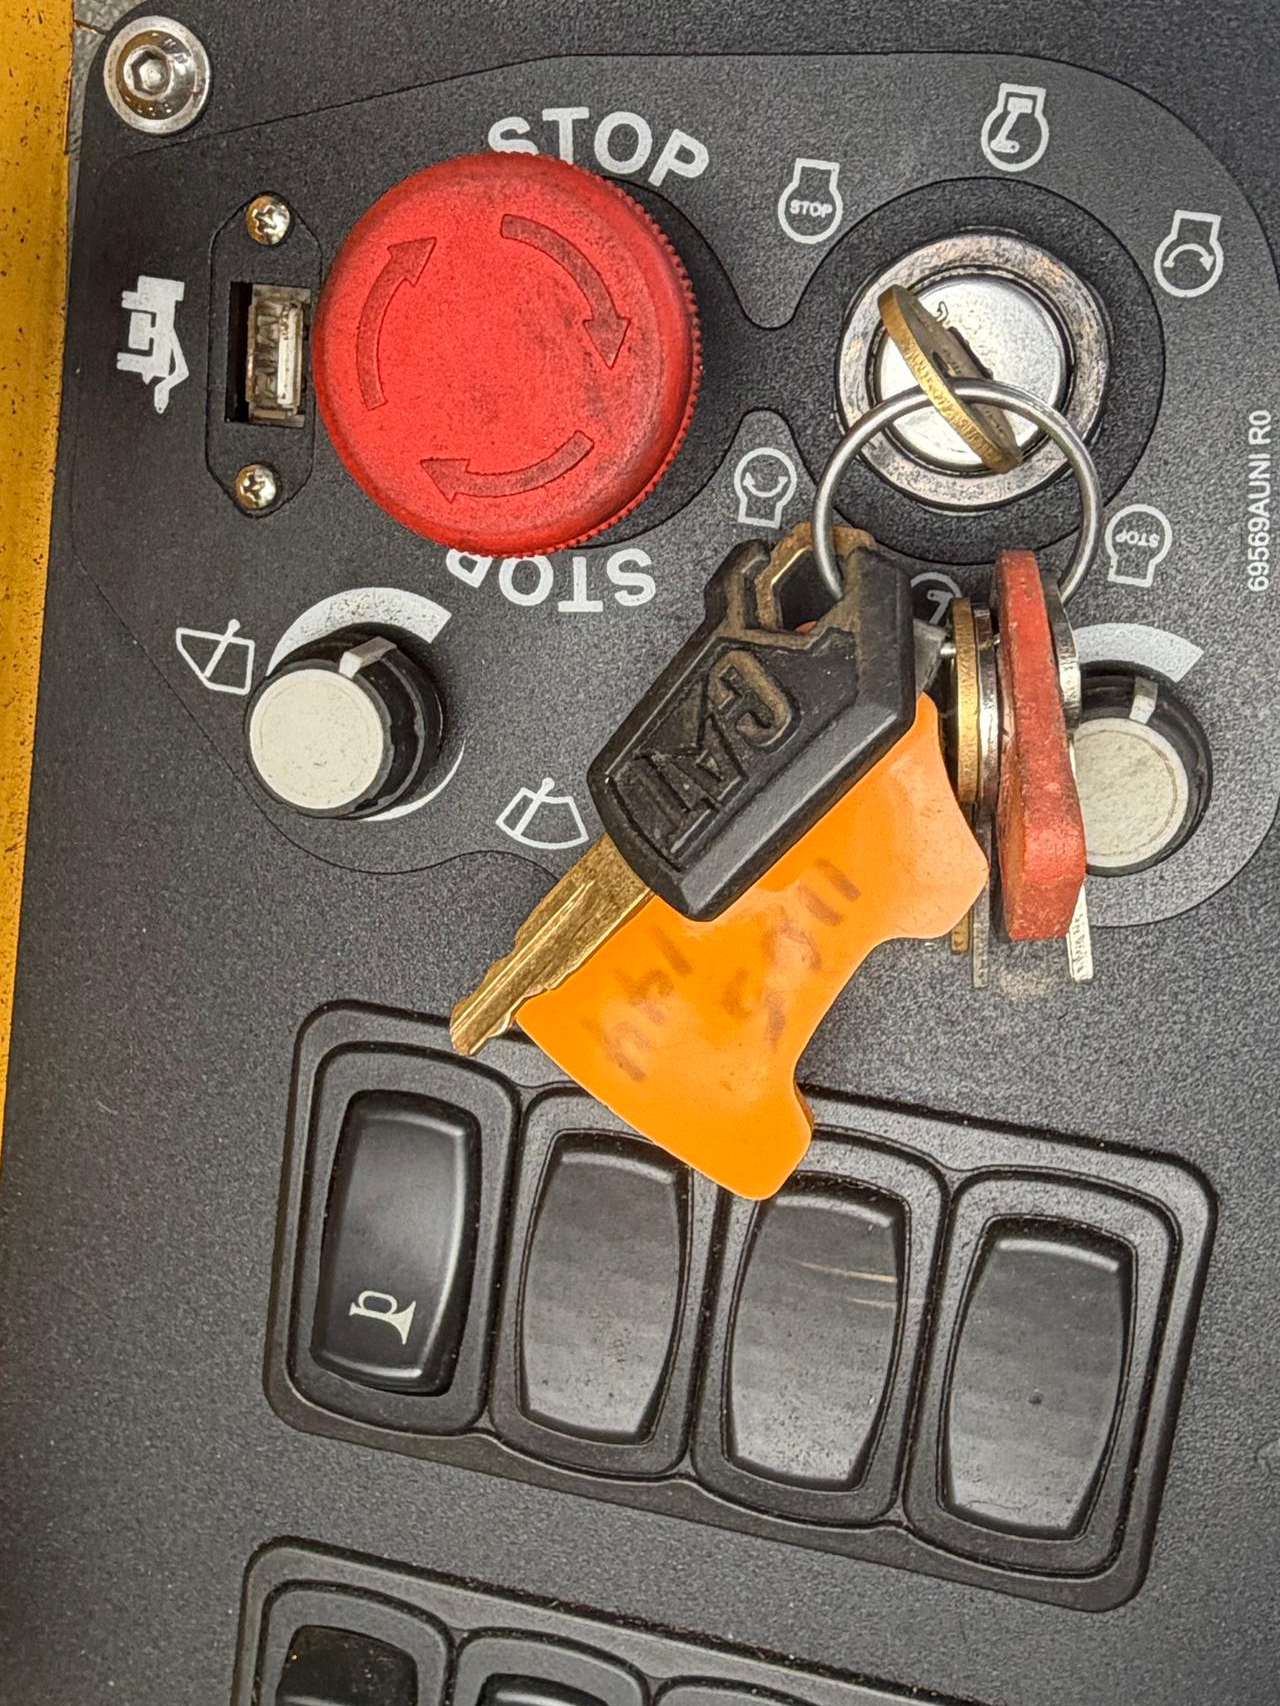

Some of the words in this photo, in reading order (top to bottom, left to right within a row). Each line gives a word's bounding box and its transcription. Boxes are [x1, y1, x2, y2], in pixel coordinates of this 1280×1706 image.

[487, 106, 710, 187] STOP
[789, 199, 834, 219] STOP
[1249, 409, 1272, 451] R0
[1115, 527, 1160, 546] STOP
[1246, 456, 1272, 593] 69569AUNI
[445, 548, 657, 613] STOP
[626, 647, 798, 865] CAT
